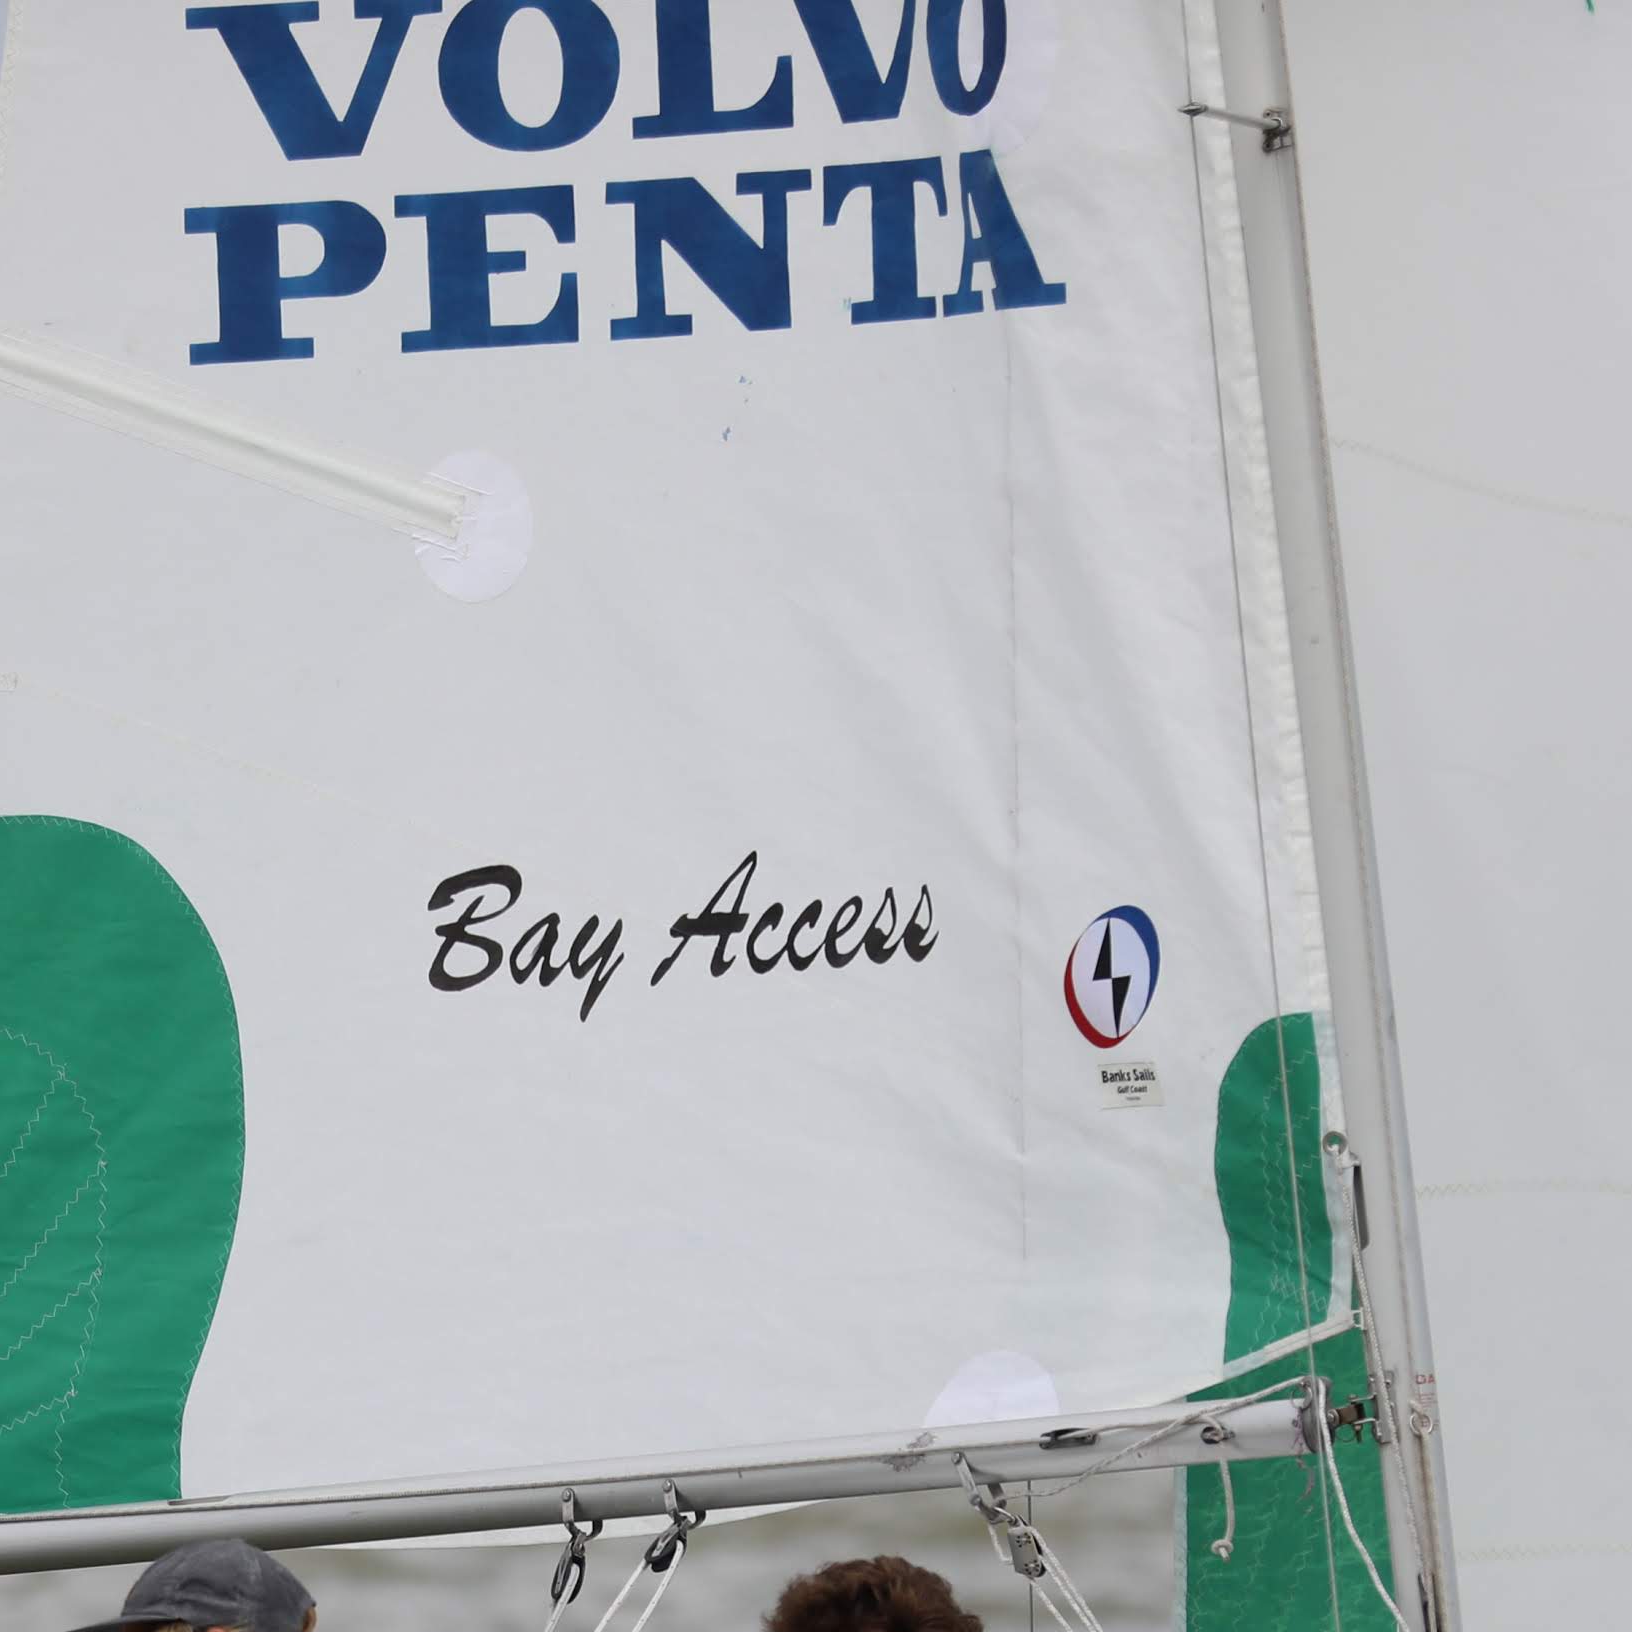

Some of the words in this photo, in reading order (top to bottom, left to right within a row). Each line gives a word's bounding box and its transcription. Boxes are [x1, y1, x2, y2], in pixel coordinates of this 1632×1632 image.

[187, 0, 1006, 160] VOLVO
[185, 152, 1066, 365] PENTA
[427, 864, 625, 1023] Bay
[650, 850, 939, 987] Access
[1101, 1069, 1131, 1083] Banks
[1133, 1068, 1156, 1081] Sails
